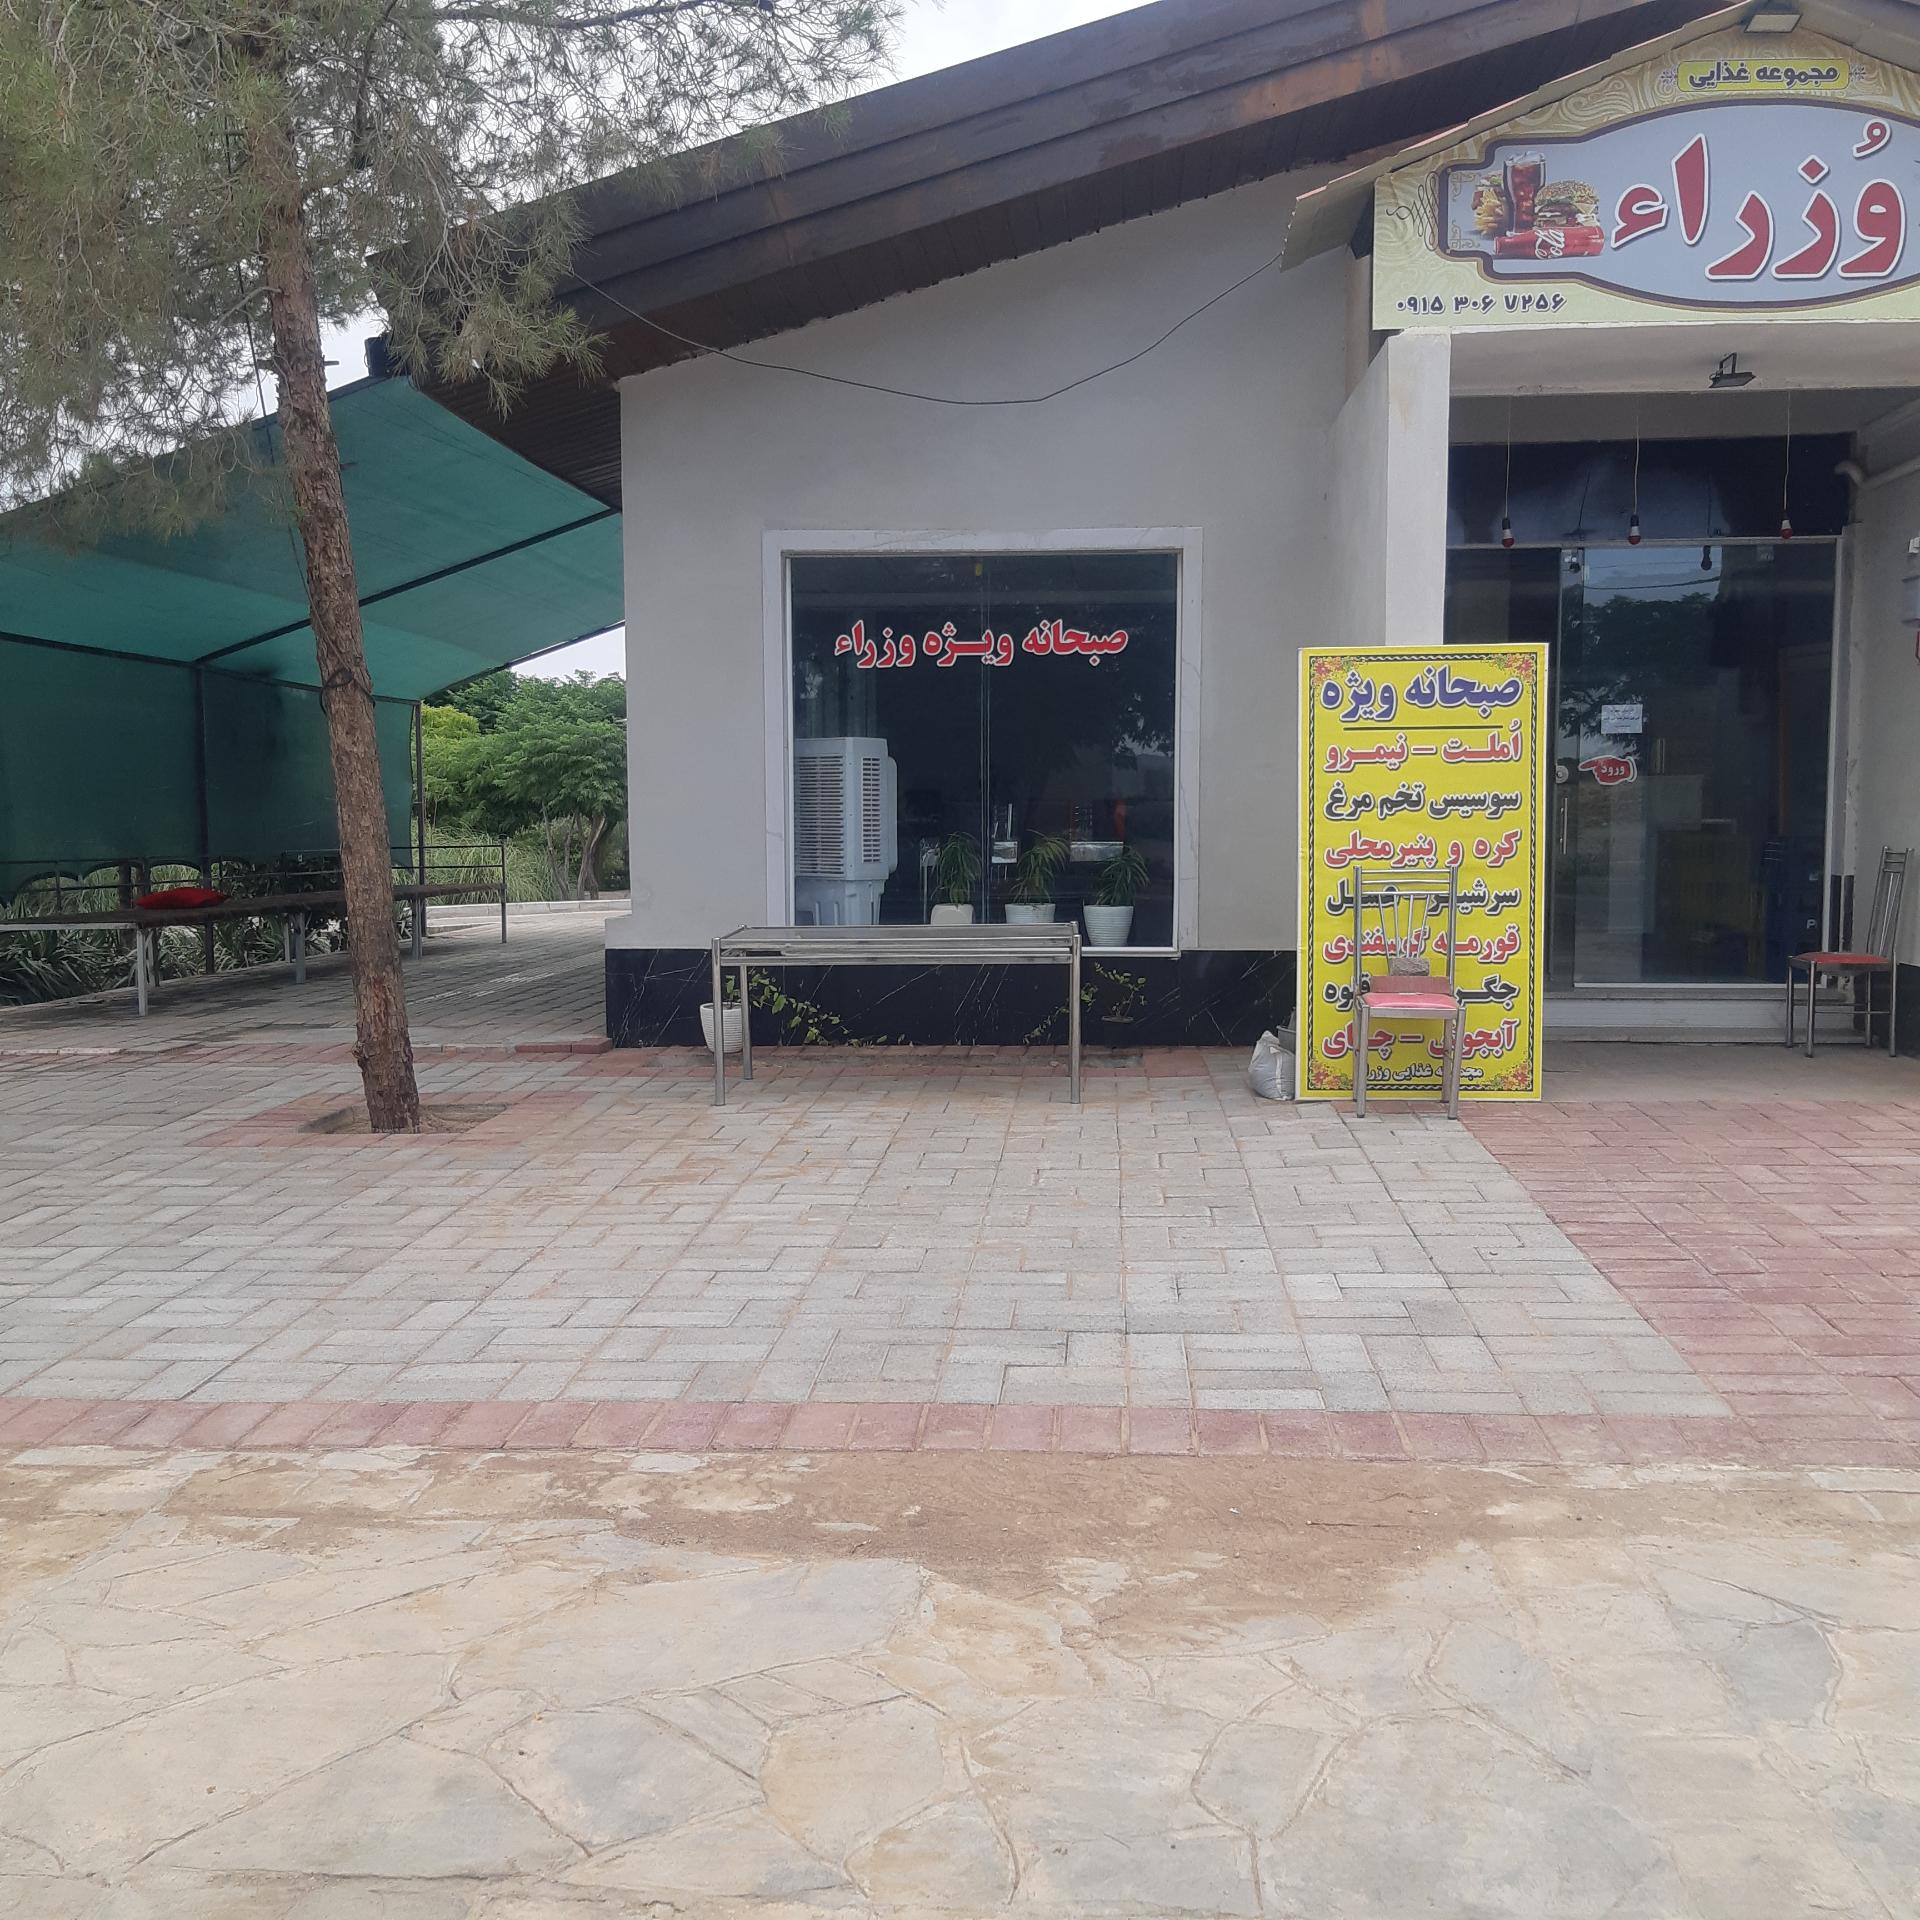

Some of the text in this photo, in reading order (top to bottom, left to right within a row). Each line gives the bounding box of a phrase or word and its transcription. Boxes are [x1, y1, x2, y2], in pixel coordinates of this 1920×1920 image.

[1689, 60, 1840, 89] مجموعه غذایی
[1396, 292, 1567, 314] ۰۹۱۵ ۳۰۶ ۷۲۵۶
[834, 620, 1129, 669] صبحانه ویژه وزراء
[1321, 665, 1523, 721] صبحانه ویژه
[1324, 733, 1408, 772] نیمرو
[1600, 765, 1625, 777] ورود
[1324, 780, 1521, 819] سوسیس تخم مرغ
[1446, 839, 1464, 867] و
[1473, 830, 1521, 865] کره
[1392, 1063, 1433, 1081] غذایی
